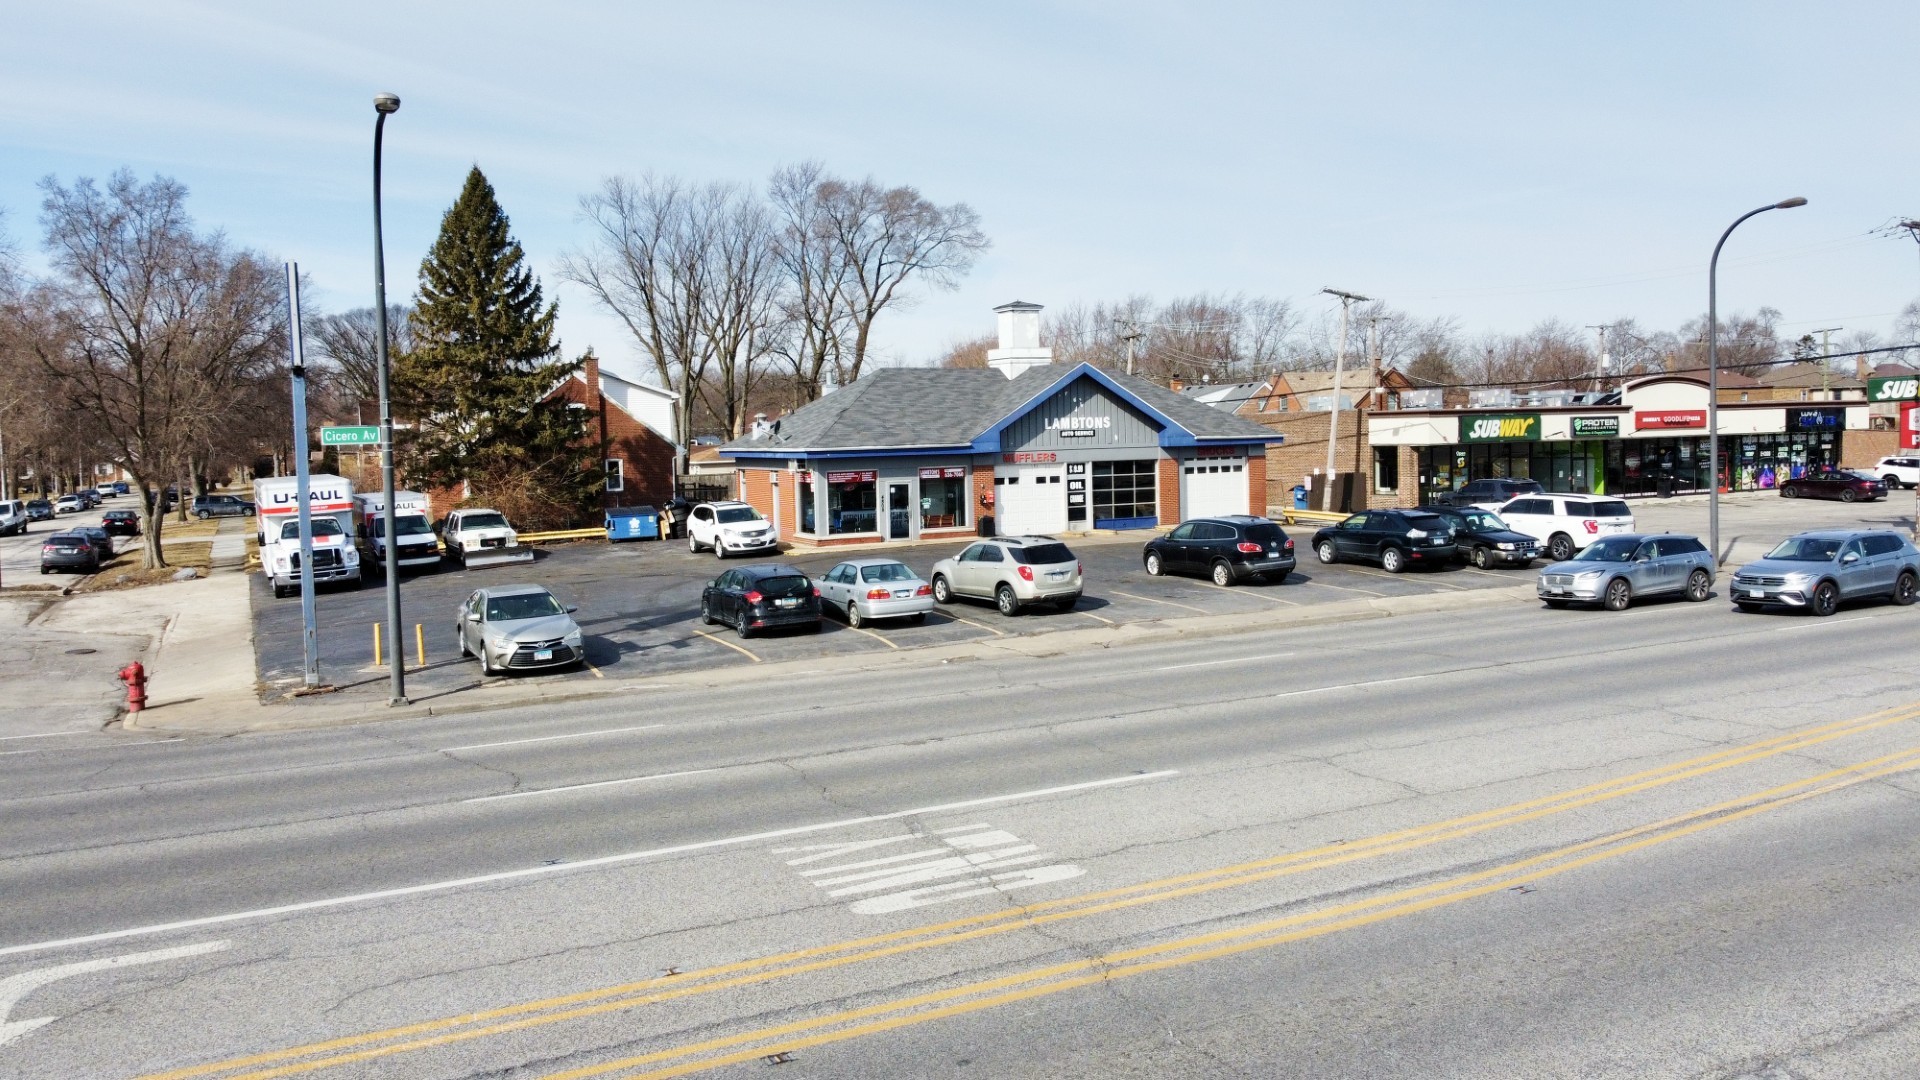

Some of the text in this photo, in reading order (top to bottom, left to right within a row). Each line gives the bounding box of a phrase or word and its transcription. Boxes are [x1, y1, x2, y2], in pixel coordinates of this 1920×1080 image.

[1876, 380, 1920, 399] SUB
[1045, 416, 1111, 429] LAMBTONS
[1469, 417, 1535, 439] SUBWAY
[1582, 418, 1618, 427] PROTEIN
[325, 430, 376, 441] Cicero Av
[1003, 452, 1057, 463] MUFFLERS
[1070, 481, 1083, 490] OIL
